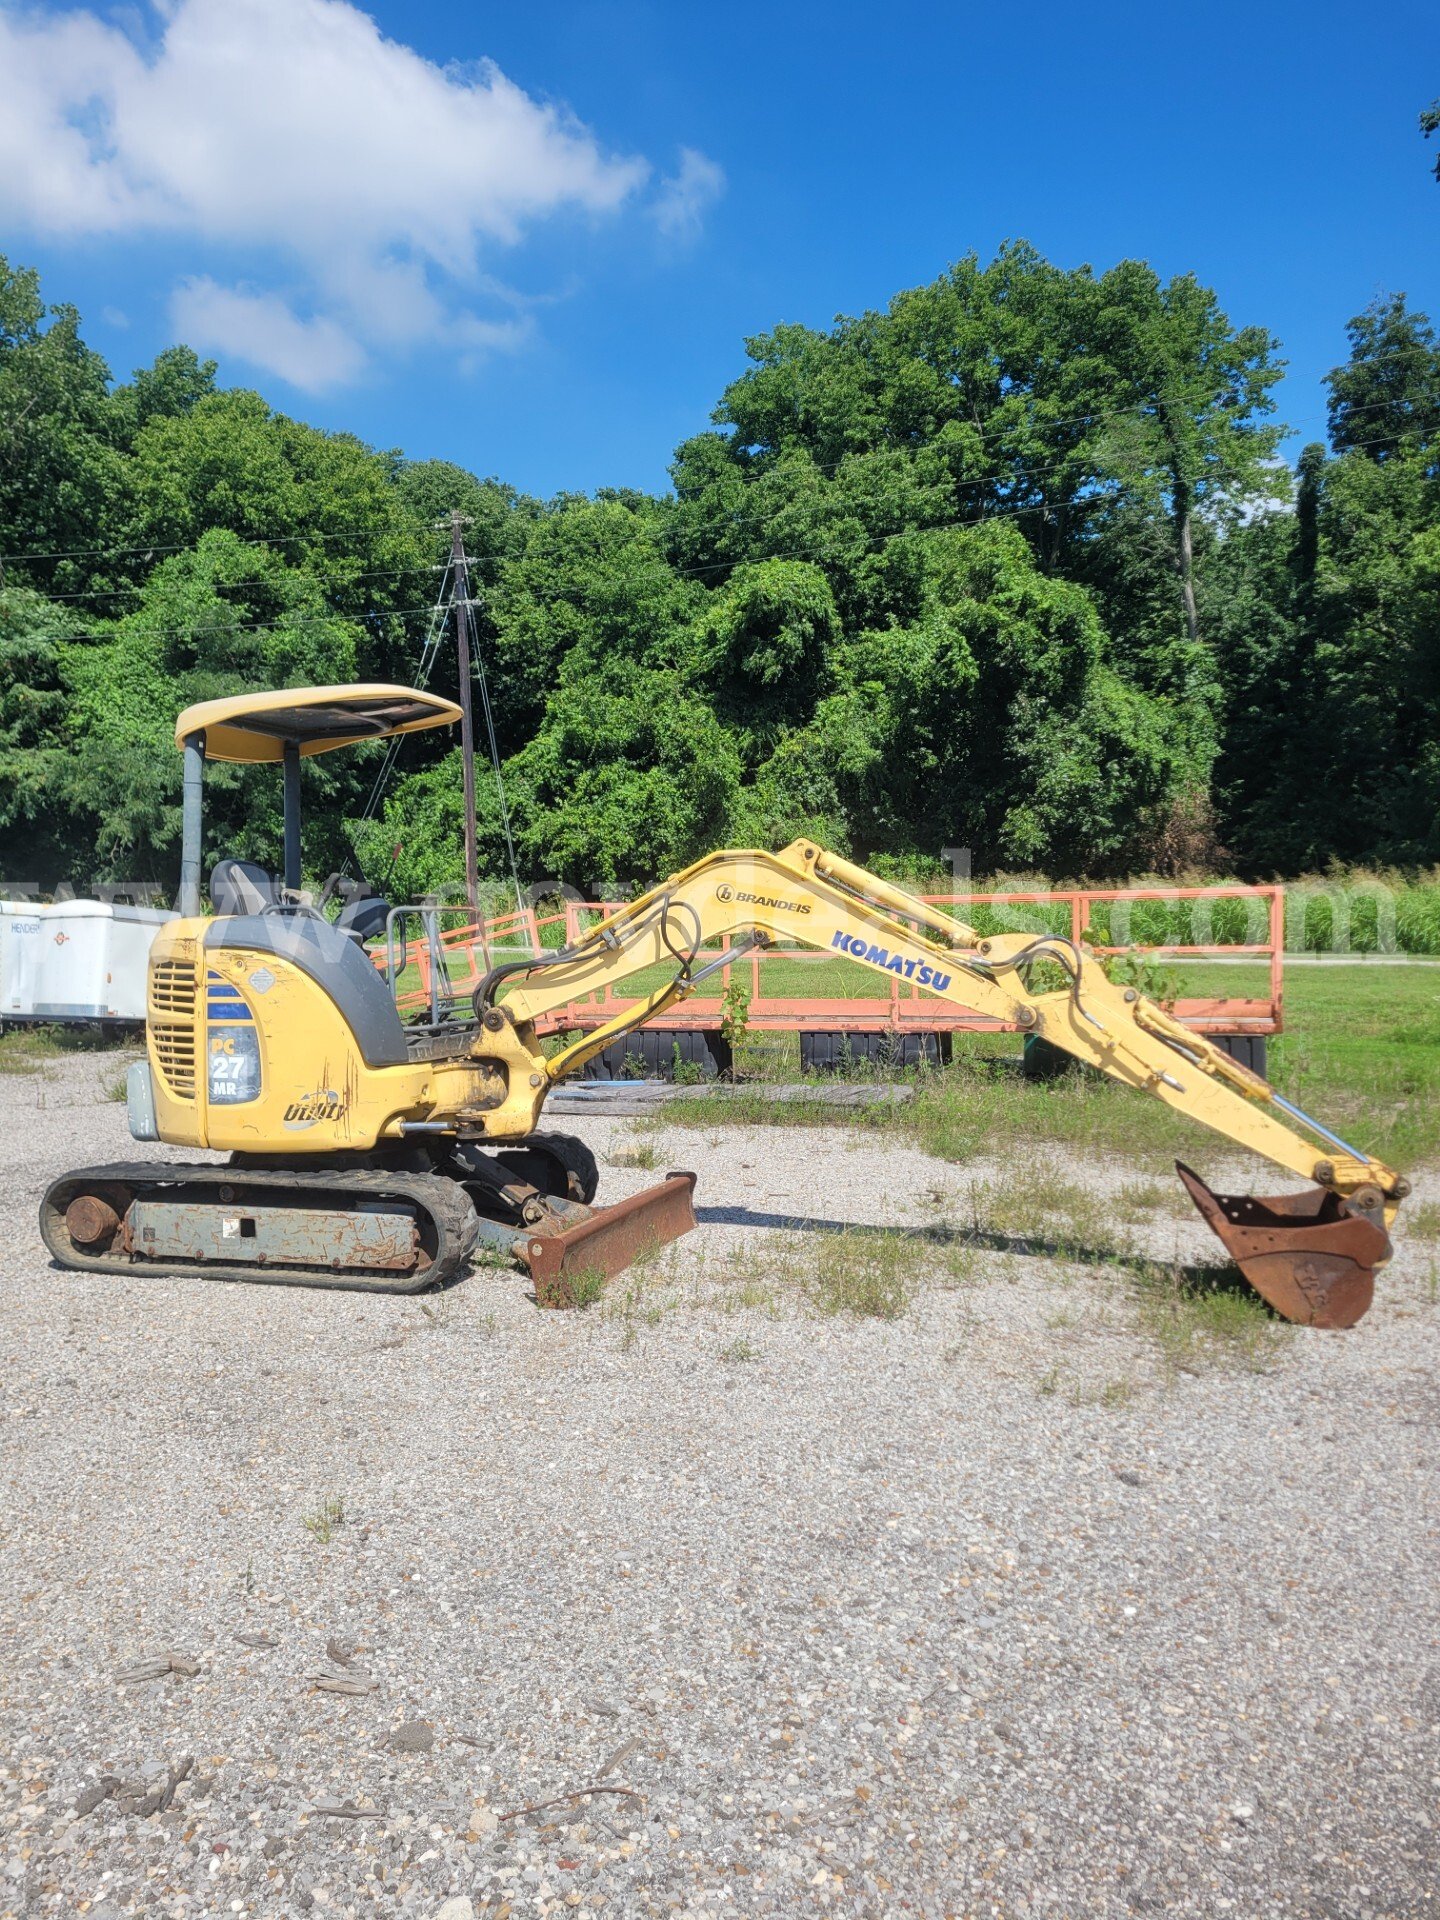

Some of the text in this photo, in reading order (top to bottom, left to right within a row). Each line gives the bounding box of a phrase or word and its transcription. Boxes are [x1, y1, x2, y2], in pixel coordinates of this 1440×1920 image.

[736, 892, 811, 914] BRANDEIS
[831, 930, 951, 991] KOMATSU
[211, 1038, 235, 1055] PC
[213, 1057, 245, 1079] 27
[213, 1082, 237, 1096] MR
[283, 1102, 345, 1121] Utility
